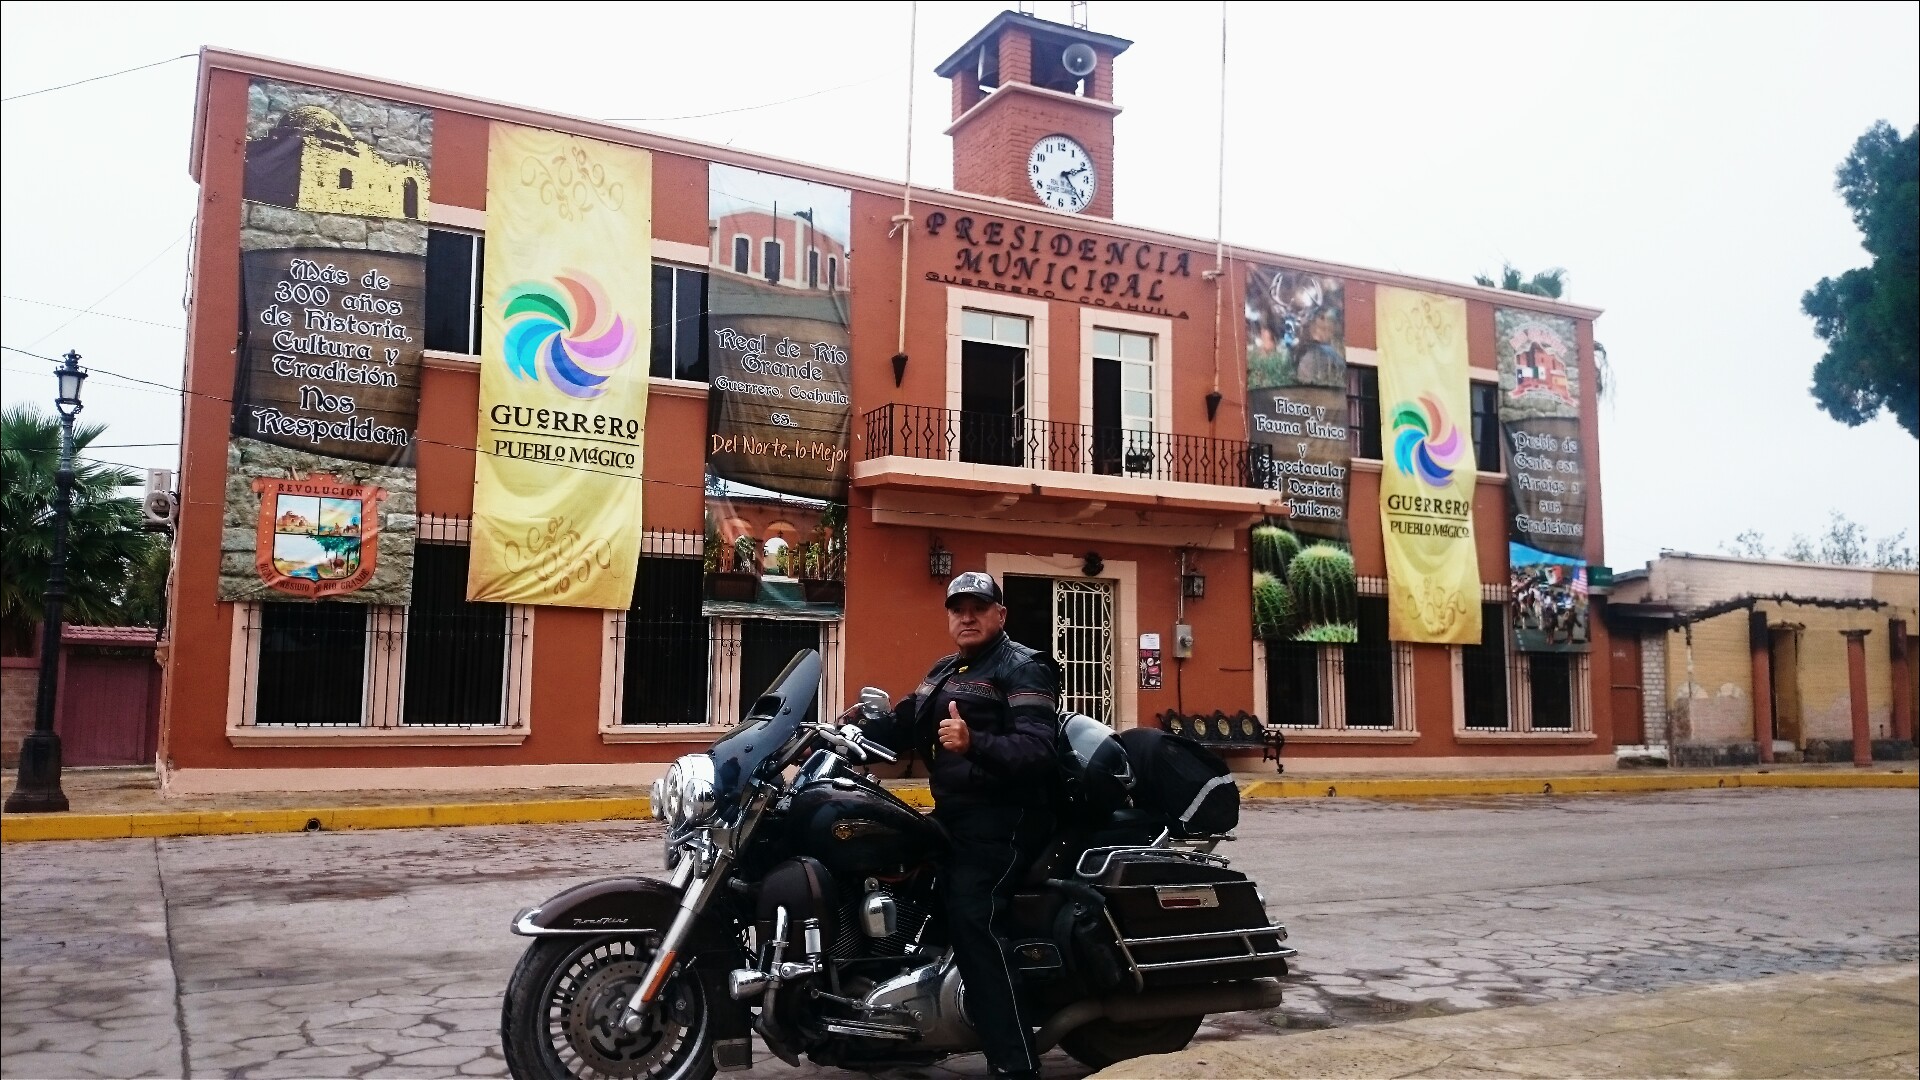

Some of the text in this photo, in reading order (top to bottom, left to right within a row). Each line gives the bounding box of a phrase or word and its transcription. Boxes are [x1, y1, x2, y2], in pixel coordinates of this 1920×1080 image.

[1036, 153, 1045, 162] 10
[1045, 143, 1053, 154] 11
[1057, 142, 1066, 152] 12
[1070, 149, 1075, 158] 1
[1033, 164, 1039, 174] 9
[1083, 175, 1089, 185] 3
[1036, 180, 1043, 189] 8
[1079, 189, 1085, 198] 4
[1046, 192, 1052, 200] 7
[1058, 198, 1064, 207] 6
[1070, 197, 1077, 206] 5
[926, 211, 1191, 277] PRESIDENCIA
[290, 258, 390, 291] Más de
[955, 247, 1164, 301] MUNICIPAL
[275, 281, 402, 316] 300 años
[925, 271, 1190, 320] GUERRERO COAHUILA
[260, 305, 292, 327] de
[273, 330, 399, 367] Cultura y
[714, 327, 848, 365] Real de Río
[272, 354, 398, 387] Tradición
[741, 352, 823, 381] Grande
[714, 375, 784, 399] Guerrero,
[299, 385, 356, 414] Nos
[1273, 397, 1325, 422] Flora y
[252, 407, 409, 446] Respaldan
[1253, 413, 1346, 440] Fauna Única
[1297, 443, 1307, 458] y
[1512, 430, 1578, 453] Pueblo de
[711, 433, 849, 473] Del Norte, lo Mejor
[1513, 451, 1553, 471] Gente
[278, 483, 364, 497] REVOLUCION
[1287, 478, 1343, 499] Desierto
[1517, 472, 1580, 496] Arraigo a
[1538, 499, 1562, 514] sus
[340, 568, 370, 589] GRANDE
